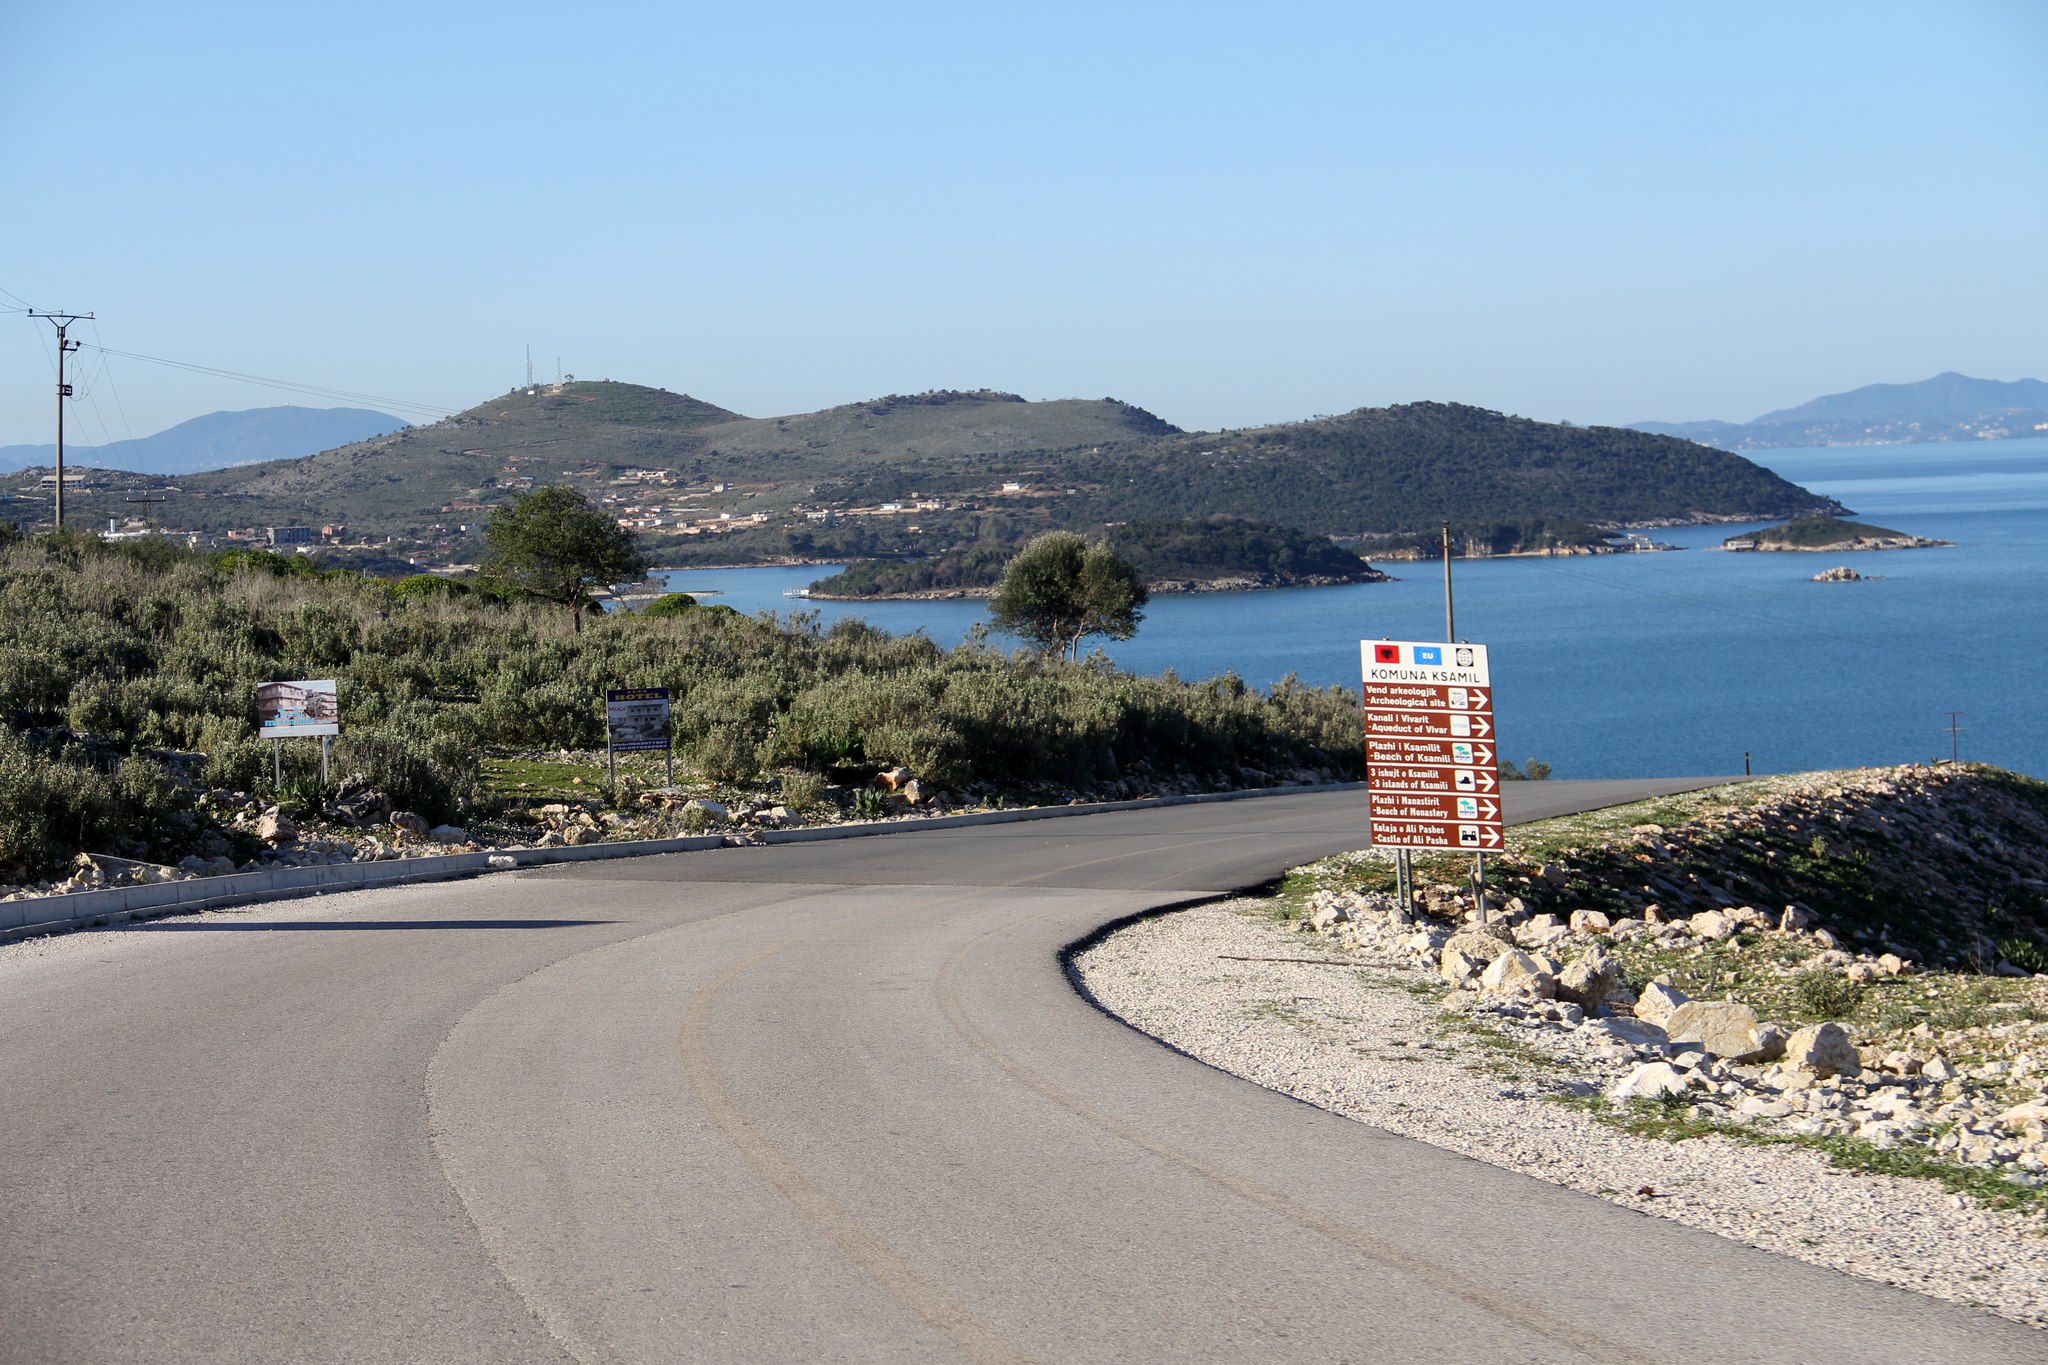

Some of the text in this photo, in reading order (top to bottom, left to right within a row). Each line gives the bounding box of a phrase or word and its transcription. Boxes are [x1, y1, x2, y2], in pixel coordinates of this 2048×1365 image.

[1422, 652, 1434, 660] EU
[1371, 668, 1480, 683] KOMUNA KSAMIL
[1366, 685, 1437, 697] Vend arkeologjik
[615, 693, 663, 701] HOTEL
[1430, 698, 1446, 707] site
[1367, 713, 1429, 724] Kanali i Vivarit
[1414, 725, 1423, 733] of
[1426, 725, 1448, 734] Vivar
[1369, 741, 1441, 752] Plazhi i Ksamilit
[1405, 753, 1414, 761] of
[1418, 753, 1451, 763] Ksamili
[1370, 768, 1376, 777] 3
[1378, 768, 1400, 778] ishujt
[1408, 769, 1439, 779] Ksamilit
[1382, 779, 1409, 789] islands
[1410, 780, 1419, 789] of
[1420, 780, 1448, 790] Ksamili
[1372, 795, 1440, 806] Plazhi i Manastirit
[1400, 807, 1408, 816] of
[1410, 807, 1448, 819] Monastery
[1373, 823, 1397, 833] Kalaja
[1405, 824, 1417, 833] Ali
[1419, 824, 1445, 834] Pashes
[1403, 835, 1411, 844] of
[1413, 835, 1424, 844] Ali
[1426, 835, 1448, 845] Pasha
